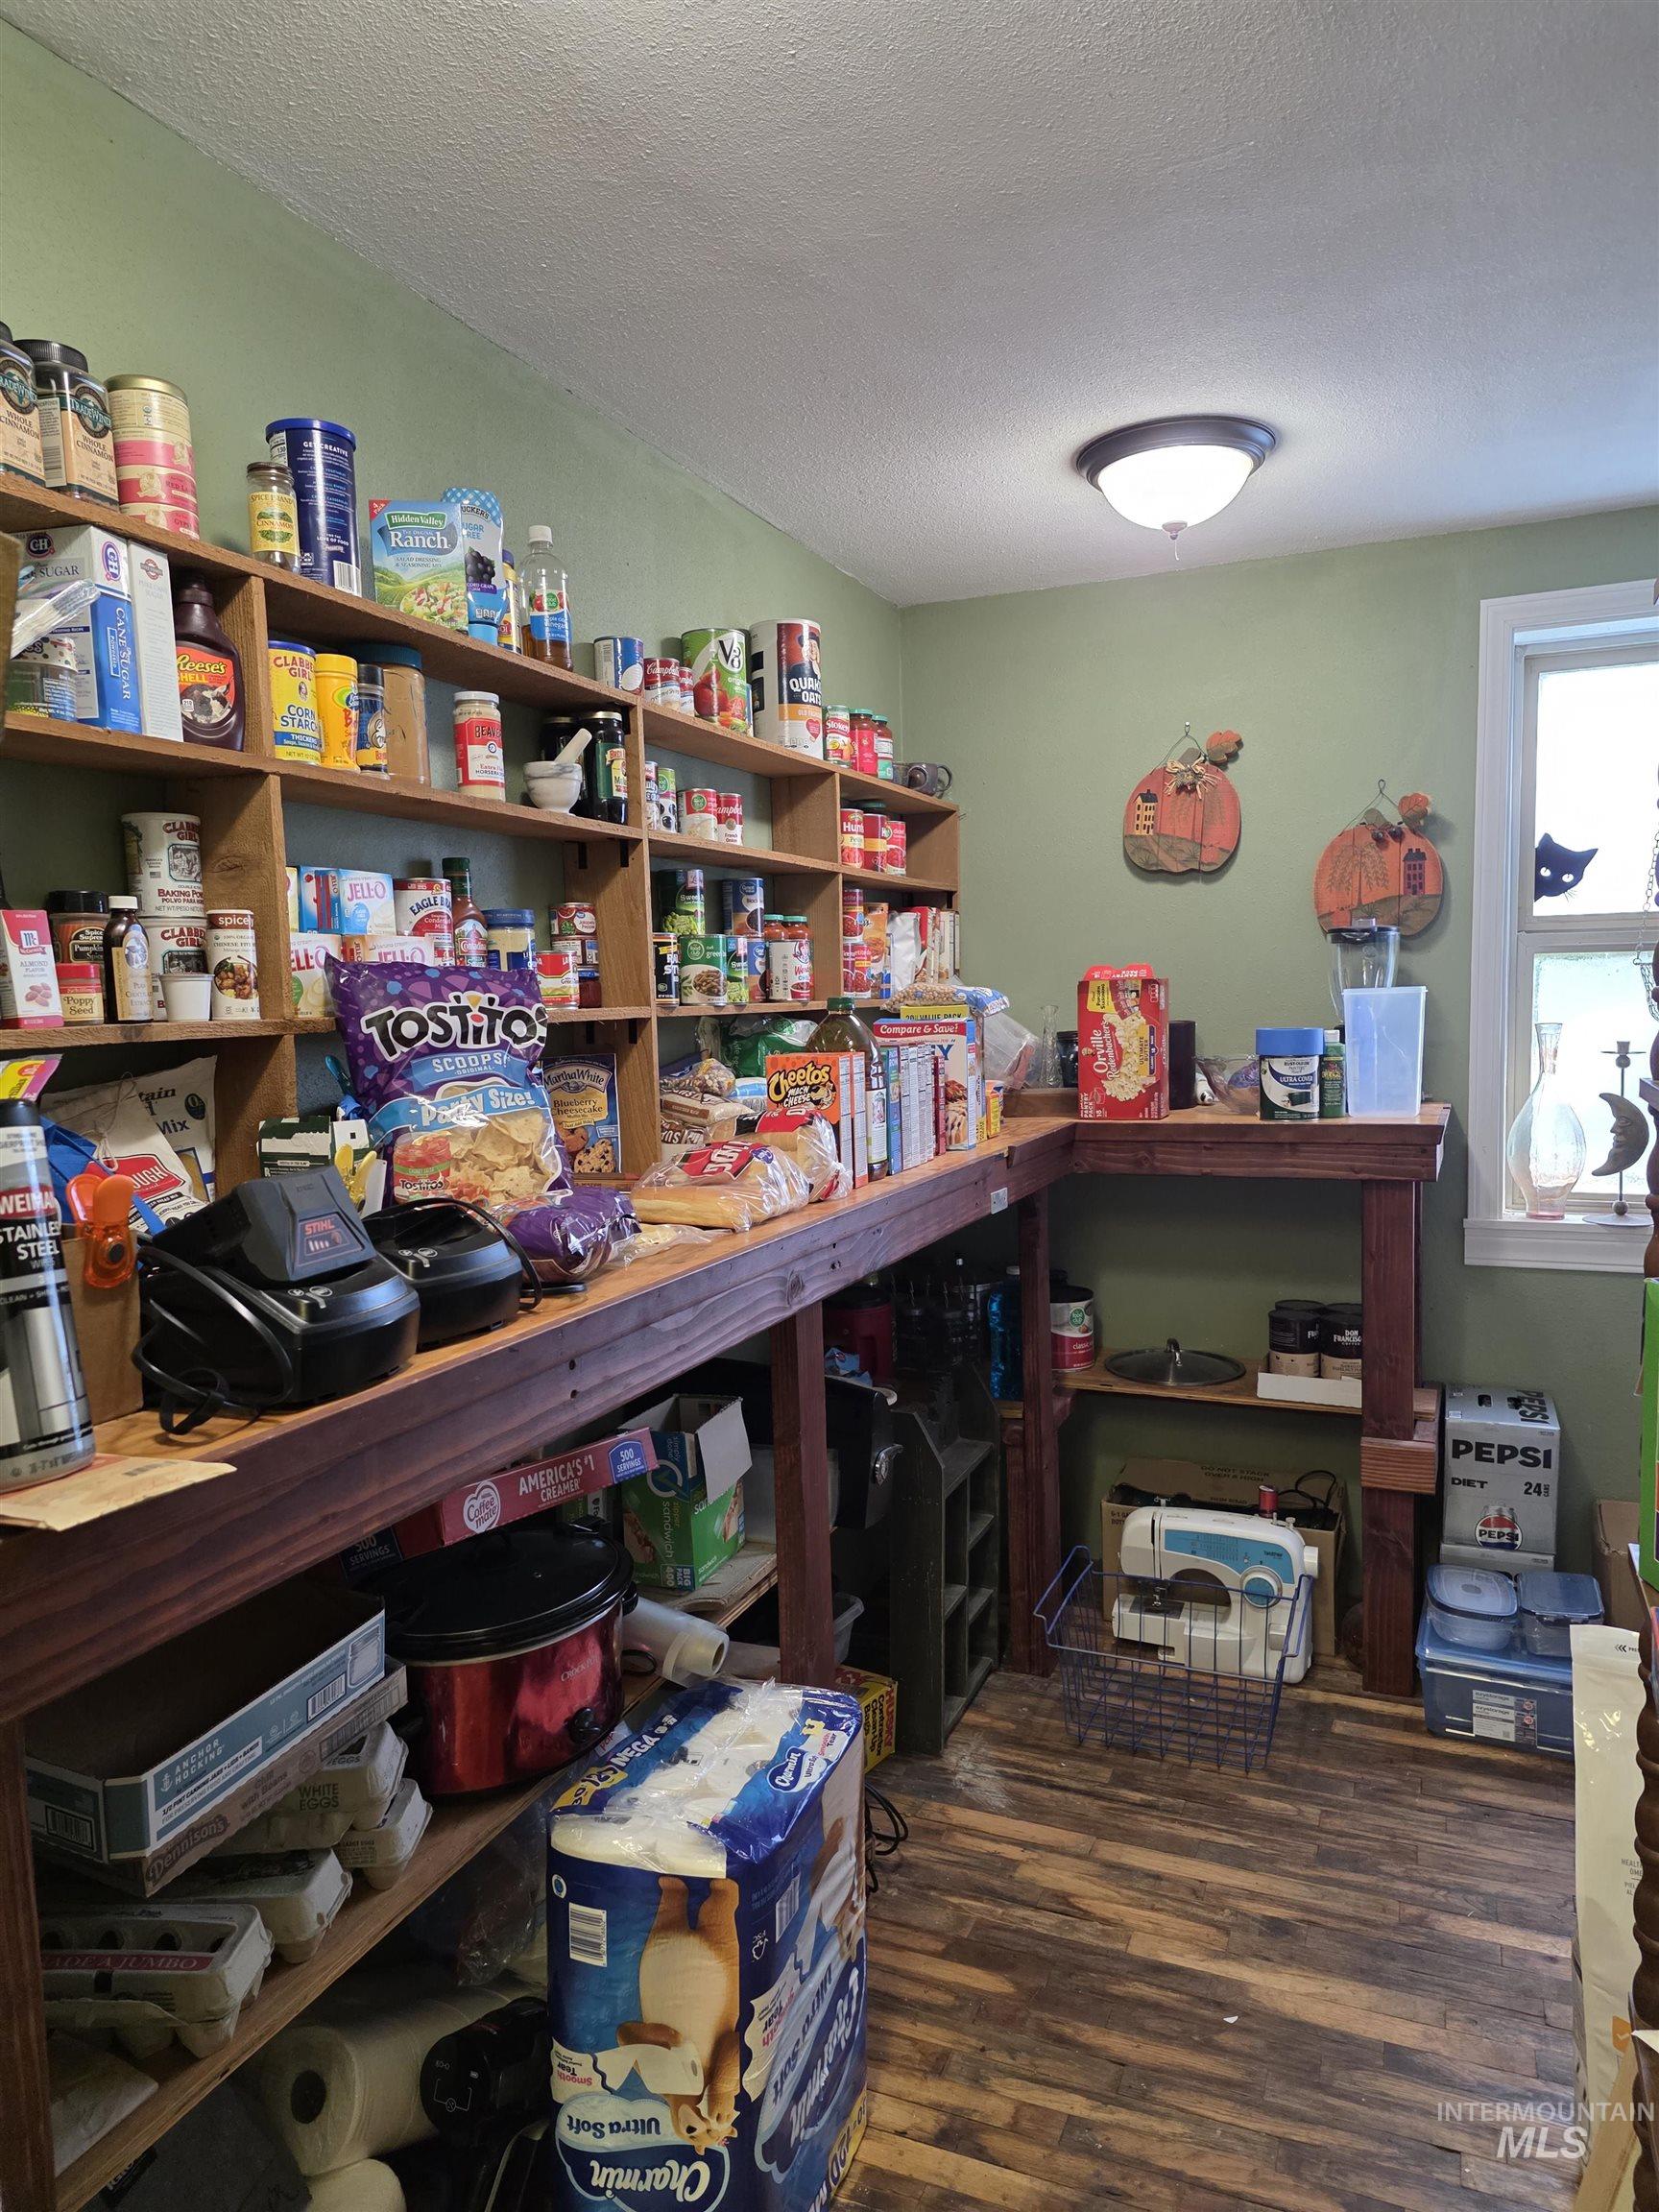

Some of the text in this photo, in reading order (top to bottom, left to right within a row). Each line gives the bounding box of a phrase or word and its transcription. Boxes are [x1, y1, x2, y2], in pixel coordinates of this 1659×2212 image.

[7, 410, 33, 429] WHOLE
[0, 416, 39, 440] CINNAMON
[77, 440, 113, 462] CINNAMON
[83, 435, 106, 451] WHOLE
[320, 444, 348, 457] CREATIVE
[251, 493, 269, 502] SPICE
[256, 519, 293, 529] CINNAMON
[391, 514, 445, 527] Hidden Valley
[390, 531, 448, 549] Ranch
[39, 565, 79, 577] SUGAR
[115, 607, 131, 699] CANE SUGAR
[718, 639, 741, 668] V8
[178, 654, 227, 674] Reese's
[274, 656, 315, 671] CLABBE
[289, 666, 312, 682] GIRL
[789, 678, 821, 693] QUAK
[288, 705, 315, 719] CORN
[475, 726, 502, 737] BEAVE
[177, 830, 197, 841] GIRL
[843, 823, 864, 832] Hunt
[157, 889, 190, 898] BAKING
[409, 897, 439, 915] EAGLE
[177, 937, 202, 947] GIRL
[290, 946, 330, 973] ELL-O
[63, 996, 94, 1008] Poppy
[69, 1005, 94, 1015] Seed
[880, 1025, 921, 1036] Compare
[933, 1023, 958, 1033] Save!
[1090, 1029, 1109, 1073] Orville
[1103, 1018, 1120, 1080] Redenbacher's
[432, 1052, 510, 1073] SCOOPS!
[456, 1067, 493, 1075] ORIGINAL
[543, 1069, 604, 1088] Martha White
[770, 1061, 830, 1098] Cheetos
[421, 1090, 535, 1126] Party Size!
[553, 1098, 597, 1108] Blueberry
[783, 1094, 811, 1108] CHEESE
[552, 1106, 603, 1116] Cheesecake
[158, 1119, 189, 1135] Mix
[400, 1179, 444, 1190] TOSTITOS
[0, 1190, 55, 1214] WEIMA
[304, 1219, 335, 1235] STIHL
[17, 1242, 60, 1261] STEEL
[620, 1448, 634, 1459] 500
[1451, 1439, 1551, 1469] PEPSI
[616, 1458, 641, 1473] SERVINGS
[519, 1458, 583, 1496] AMERICA'S
[1451, 1477, 1488, 1489] DIET
[541, 1479, 580, 1502] CREAMER
[1524, 1481, 1542, 1497] 24
[468, 1497, 494, 1523] Coffee
[475, 1505, 497, 1528] mate
[662, 1501, 671, 1558] sandwich
[1479, 1528, 1519, 1542] PEPSI
[349, 1545, 391, 1566] SERVINGS
[684, 1567, 692, 1587] BIG
[818, 1732, 830, 1756] Smooth
[827, 1733, 836, 1747] Tear
[176, 1739, 219, 1772] ANCHOR
[610, 1734, 661, 1767] MEGA
[175, 1745, 223, 1784] HOCKING
[775, 1752, 801, 1787] Charmin
[299, 1783, 339, 1797] WHITE
[300, 1795, 339, 1811] EGGS
[117, 1956, 199, 1970] JUMBO
[790, 1966, 859, 2149] Charmin
[558, 2063, 578, 2077] Tear
[558, 2071, 592, 2087] Smooth
[566, 2114, 661, 2139] Ultra Soft
[589, 2159, 710, 2203] Charmin
